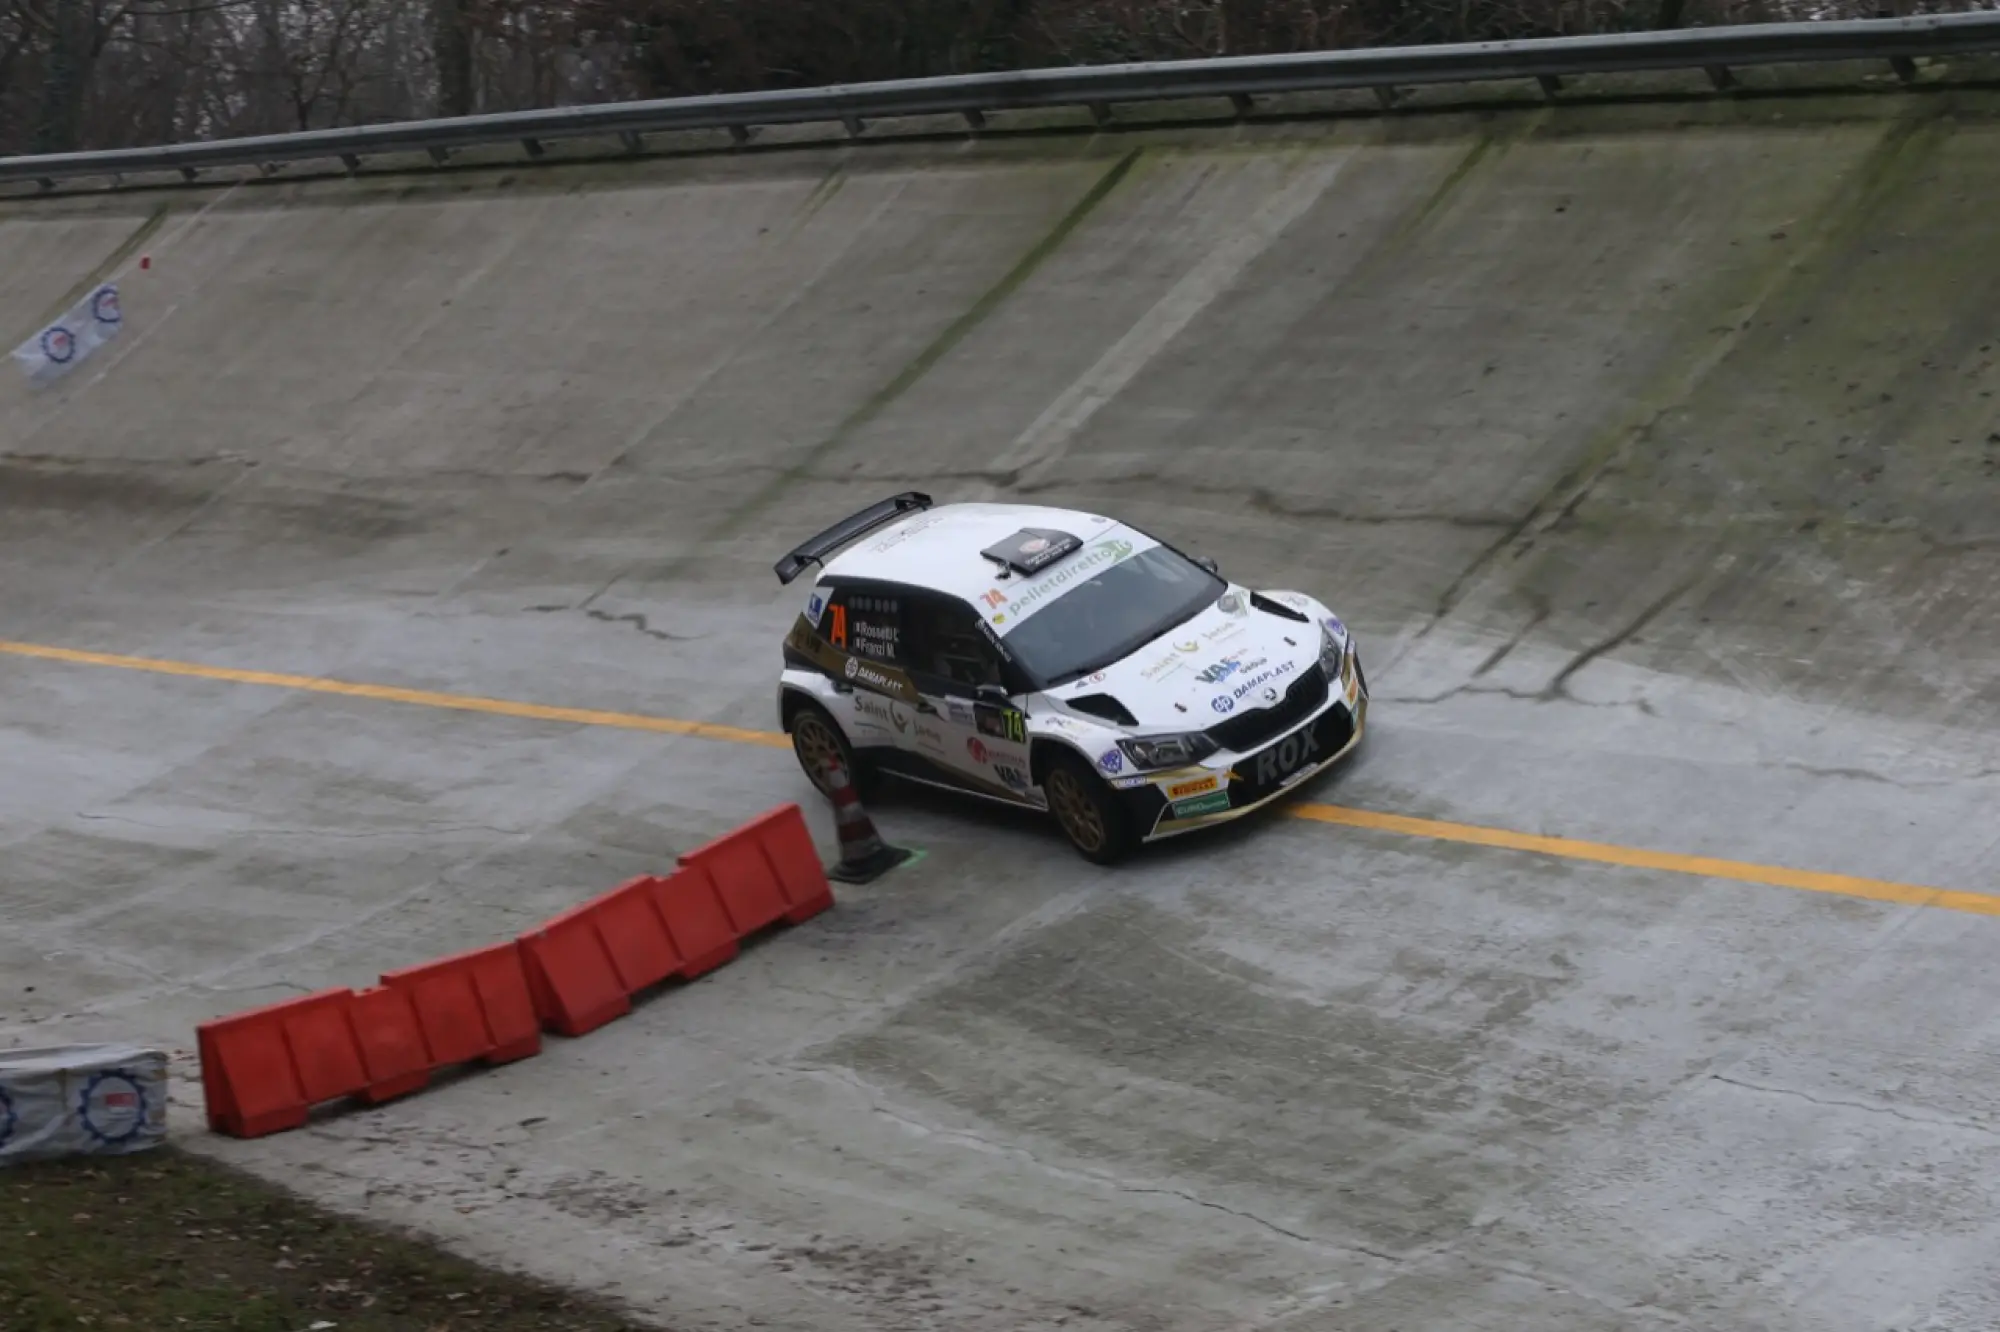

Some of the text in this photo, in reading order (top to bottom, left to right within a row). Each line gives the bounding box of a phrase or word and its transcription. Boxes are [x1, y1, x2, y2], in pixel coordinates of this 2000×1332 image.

[1009, 549, 1112, 616] pelletdiretto
[828, 603, 847, 651] 74
[1233, 660, 1296, 699] DAMAPLAST
[854, 695, 890, 722] Saint
[1257, 721, 1319, 786] ROX
